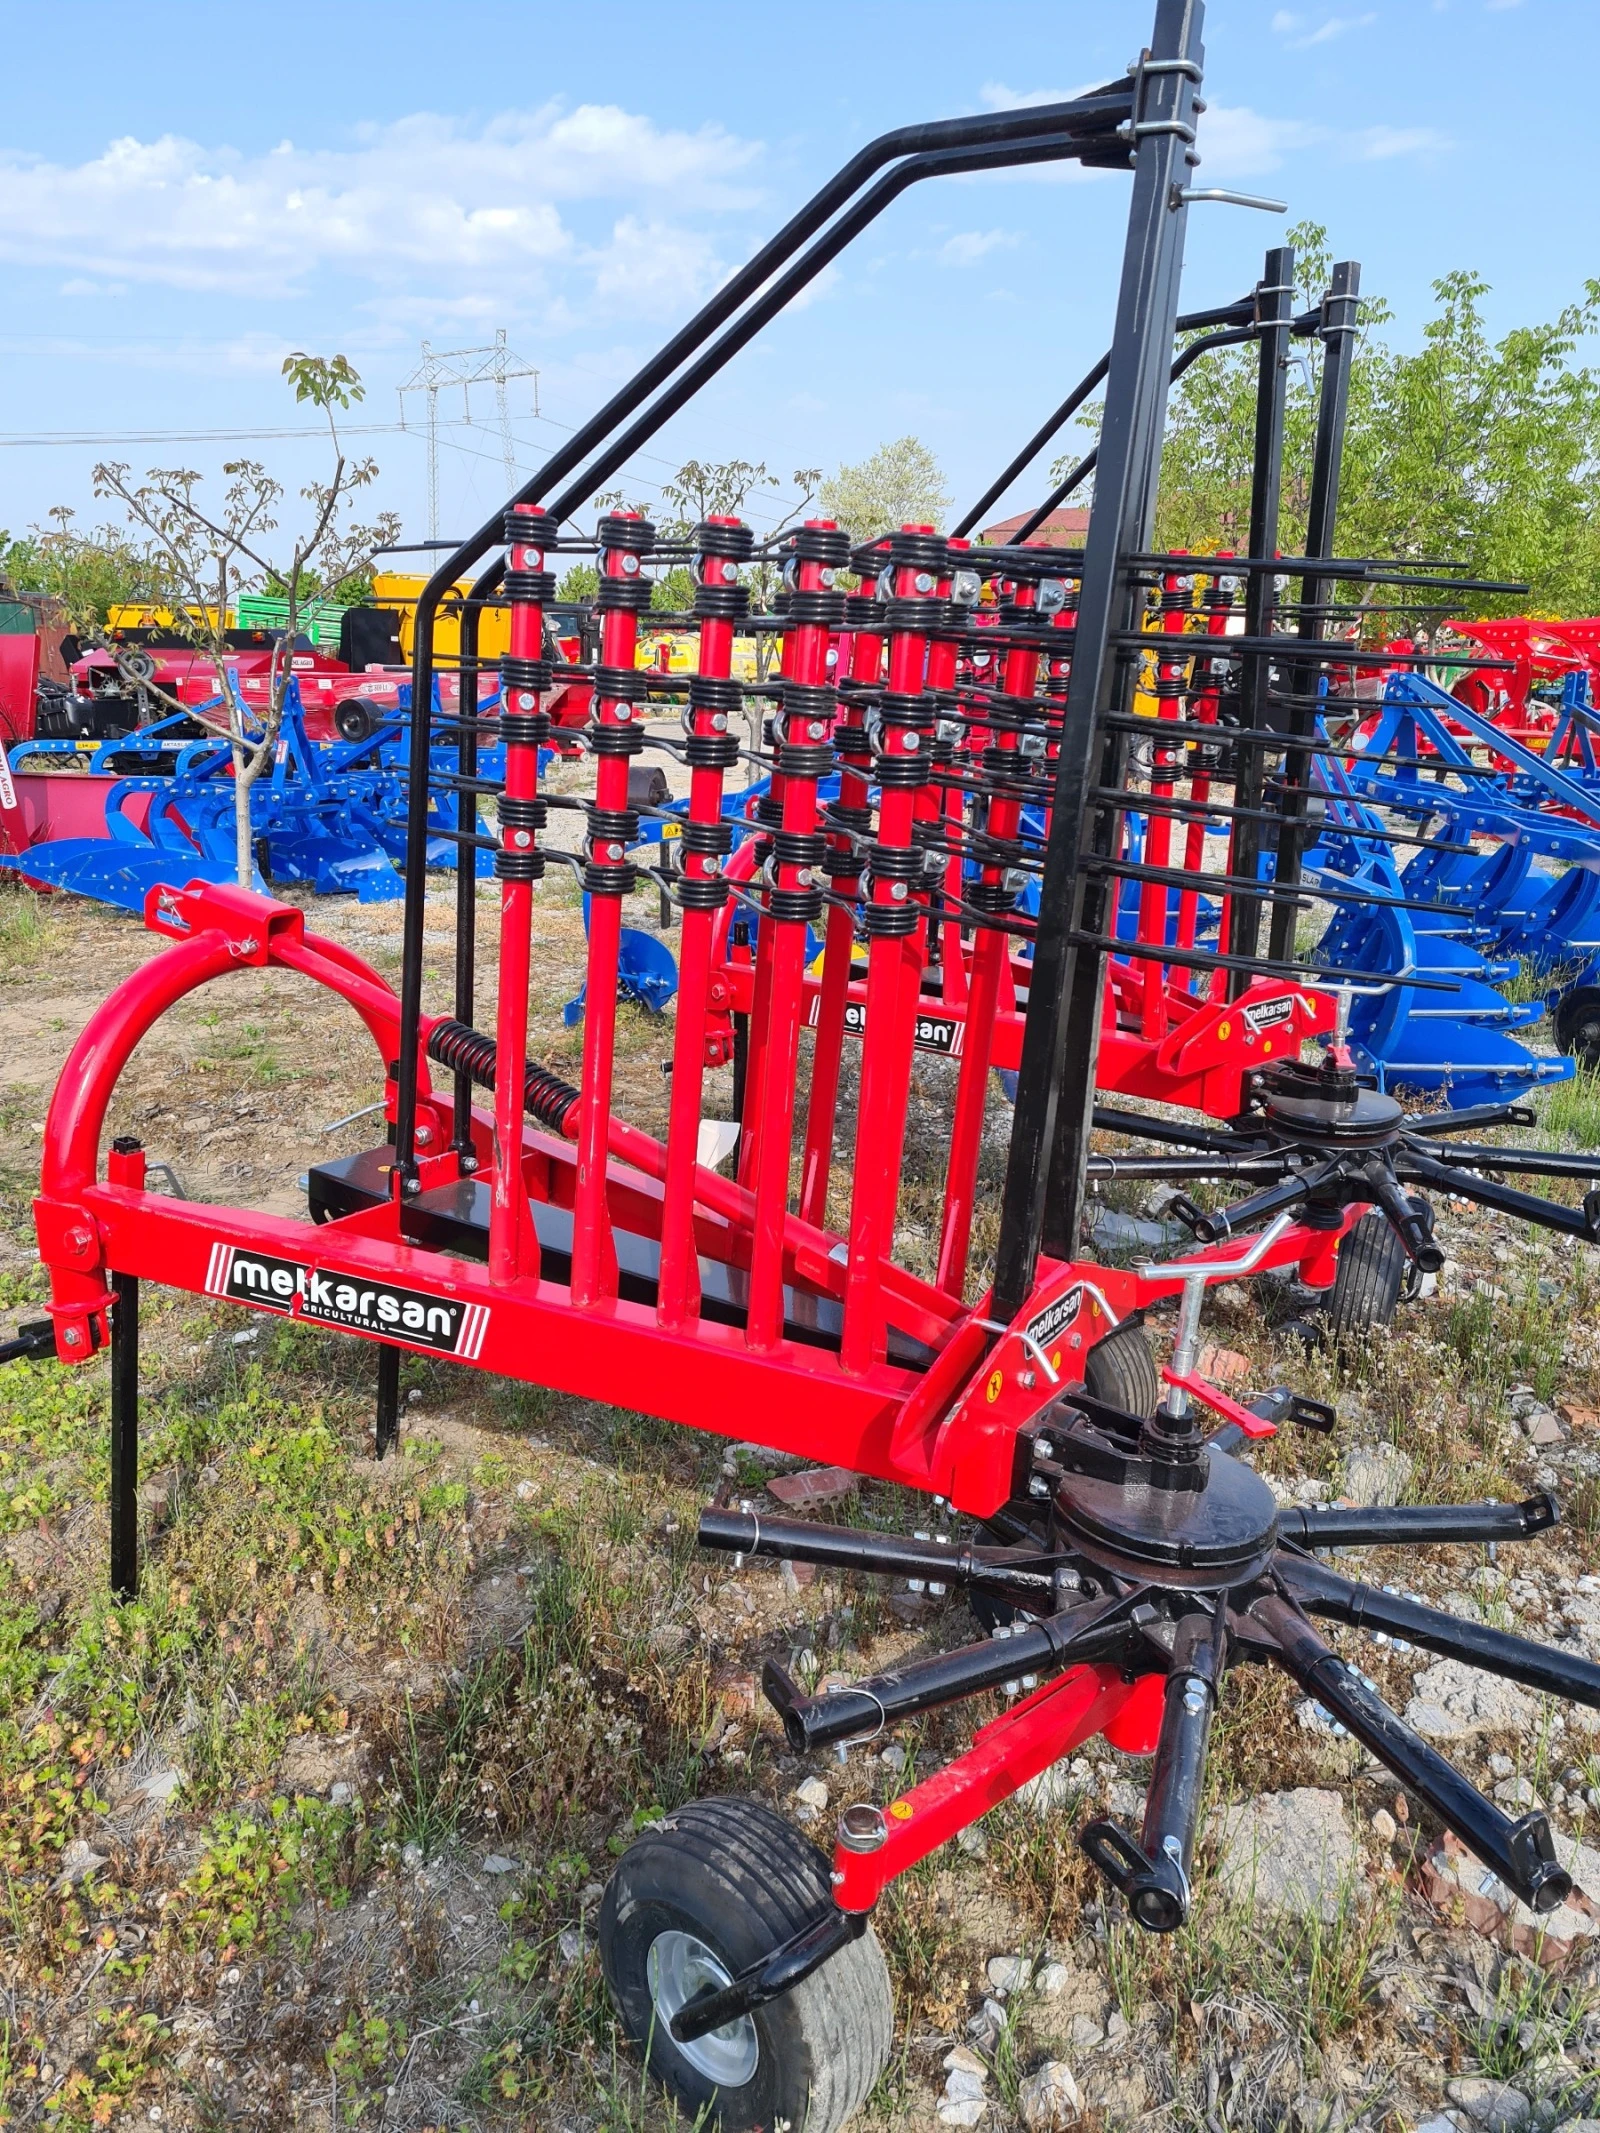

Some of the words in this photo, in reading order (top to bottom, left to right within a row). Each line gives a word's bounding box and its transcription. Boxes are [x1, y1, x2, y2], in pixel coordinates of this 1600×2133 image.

[0, 776, 13, 805] AGRO
[233, 1259, 452, 1337] melkarsan
[302, 1302, 387, 1332] GRICULTURAL
[1028, 1290, 1081, 1341] melkarsan
